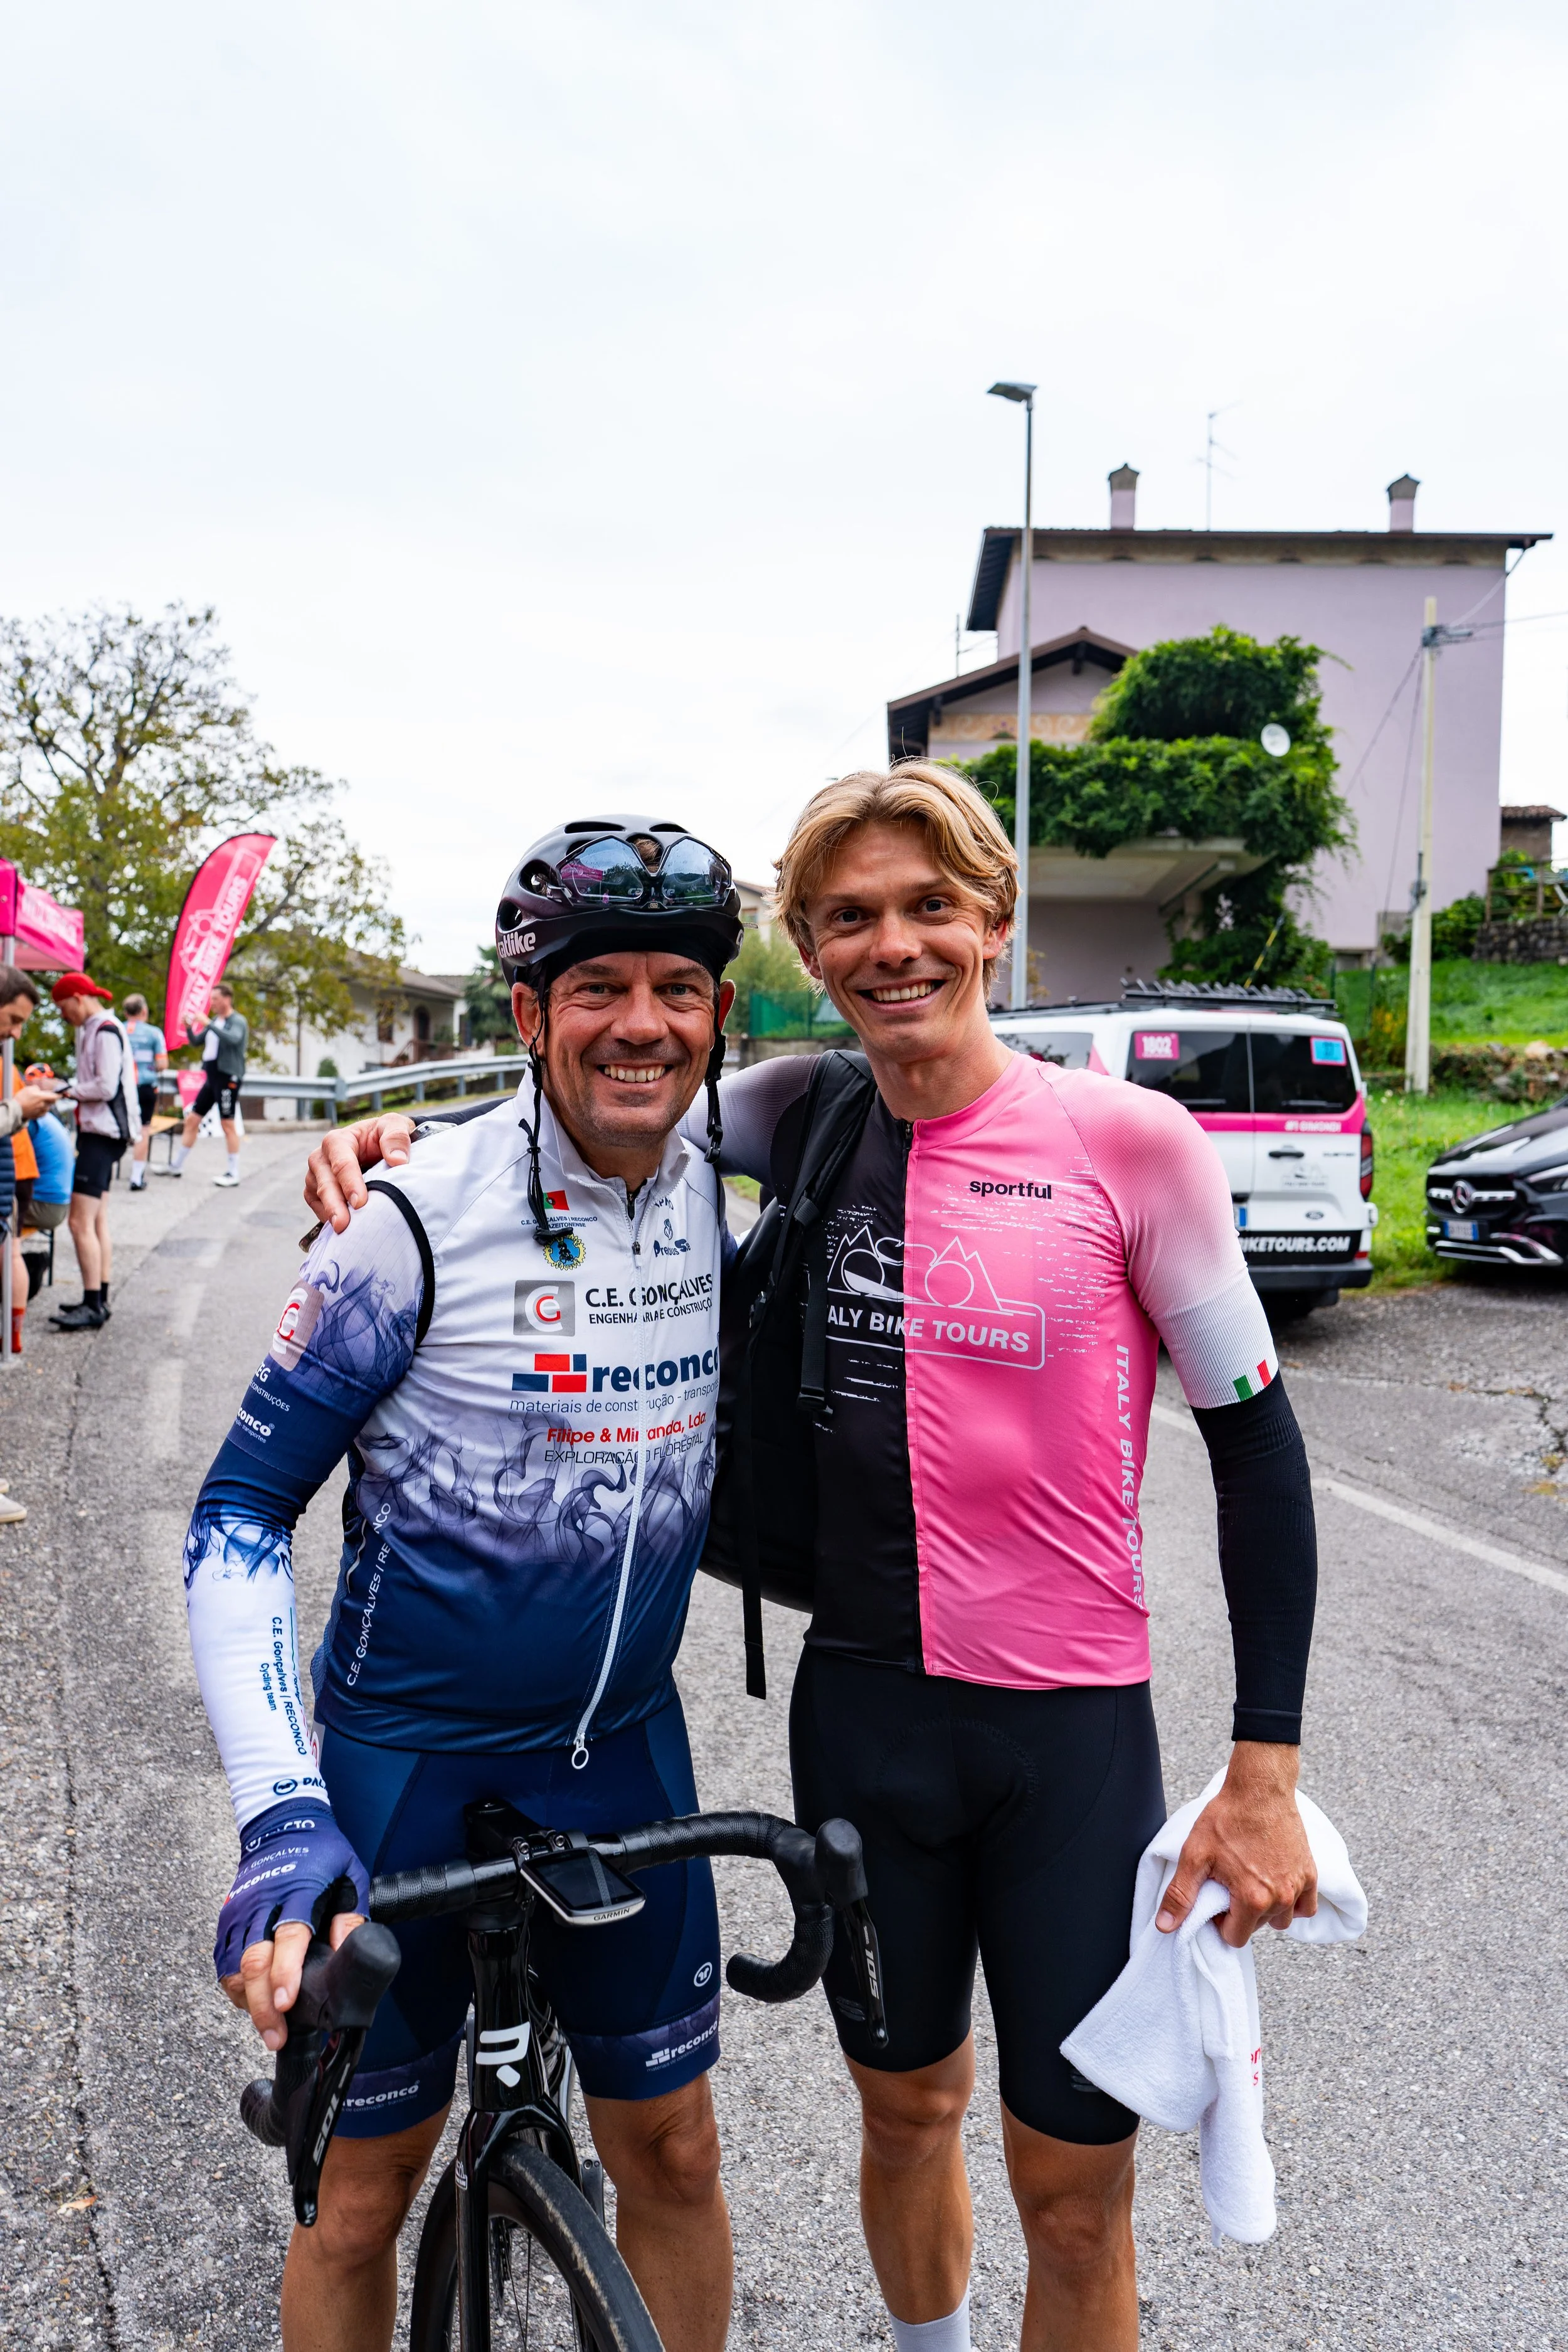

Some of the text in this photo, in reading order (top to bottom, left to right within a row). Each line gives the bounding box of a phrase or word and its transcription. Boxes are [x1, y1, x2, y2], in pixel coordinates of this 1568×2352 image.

[201, 936, 223, 977] BIKE
[215, 875, 248, 934] TOURS
[969, 1180, 1052, 1200] sportful
[585, 1288, 624, 1307] C.E.
[827, 1305, 1030, 1352] ALY BIKE TOURS
[510, 1399, 581, 1413] materiais
[586, 1399, 601, 1412] de
[1116, 1344, 1131, 1432] ITALY
[547, 1428, 595, 1445] Filipe
[600, 1428, 612, 1443] &
[653, 1432, 704, 1460] FLORESTAL
[1120, 1438, 1135, 1507] BIKE
[272, 1616, 282, 1637] C.E.
[347, 1661, 361, 1686] C.E.
[356, 1574, 381, 1659] GONÇALVES
[261, 1663, 277, 1711] Cycling team
[274, 1641, 287, 1693] Gonçalves
[284, 1701, 307, 1755] RECONCO
[593, 1909, 630, 1922] GARMIN
[865, 1949, 879, 2000] 105
[671, 2020, 718, 2058] reconco
[347, 2084, 419, 2107] reconco
